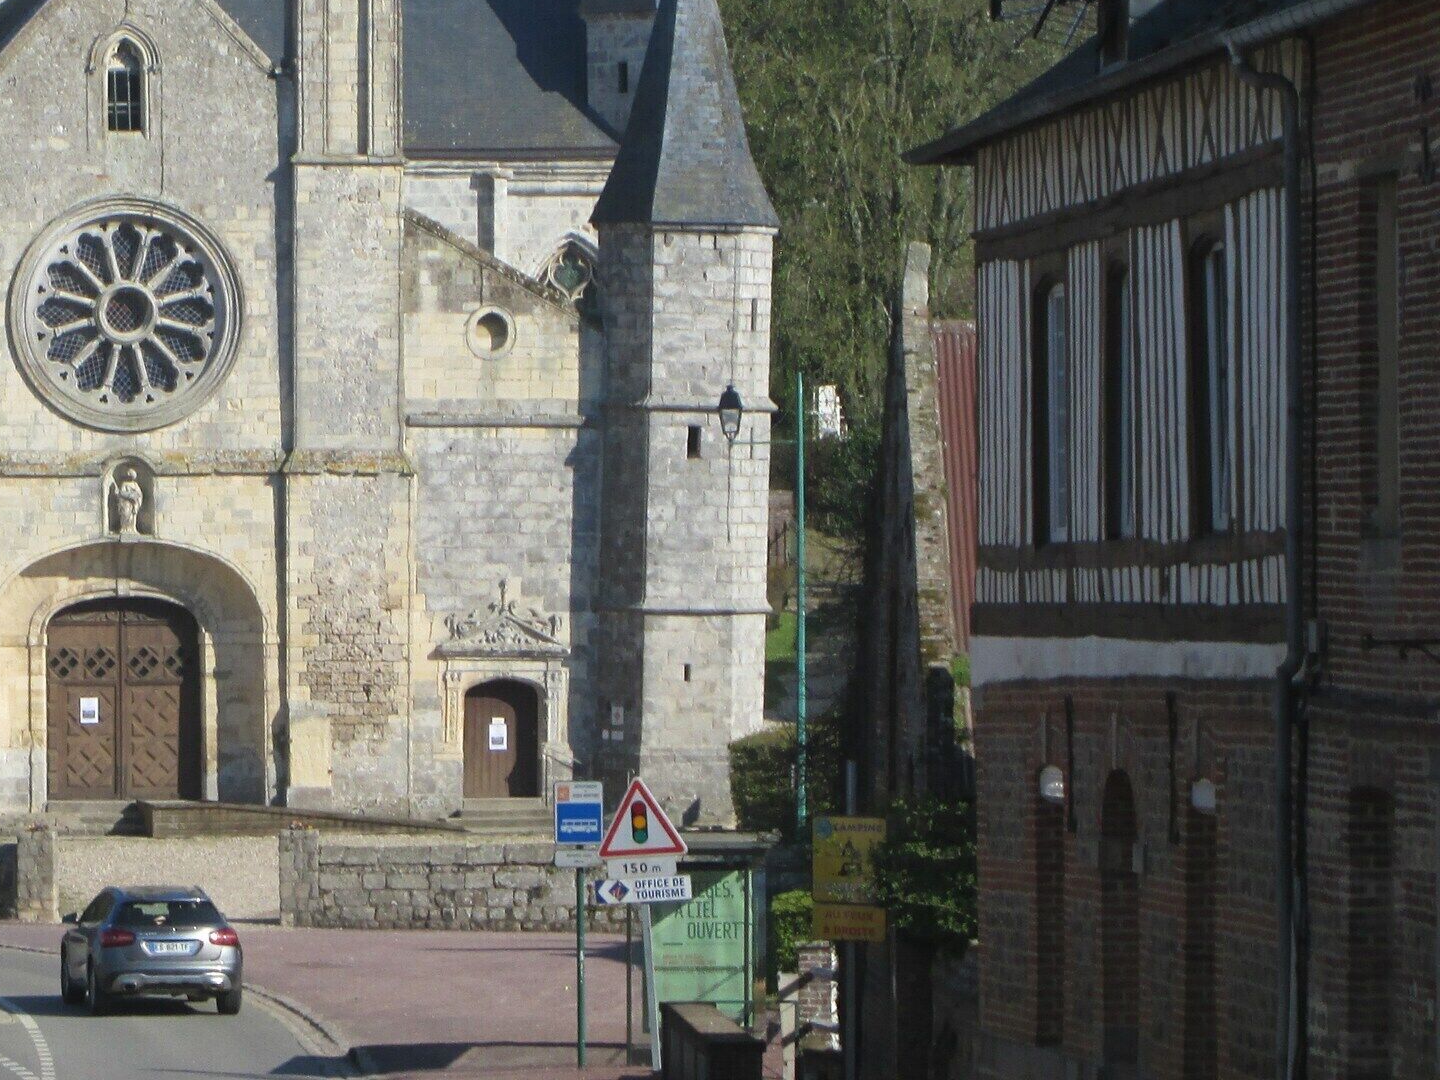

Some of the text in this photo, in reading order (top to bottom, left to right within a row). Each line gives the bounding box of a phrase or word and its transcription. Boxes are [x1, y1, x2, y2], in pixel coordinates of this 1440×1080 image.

[623, 862, 648, 874] 150
[634, 877, 685, 889] OFFICE DE
[636, 888, 686, 900] TOURISME
[687, 901, 719, 919] CIEL
[687, 921, 741, 940] OUVERT
